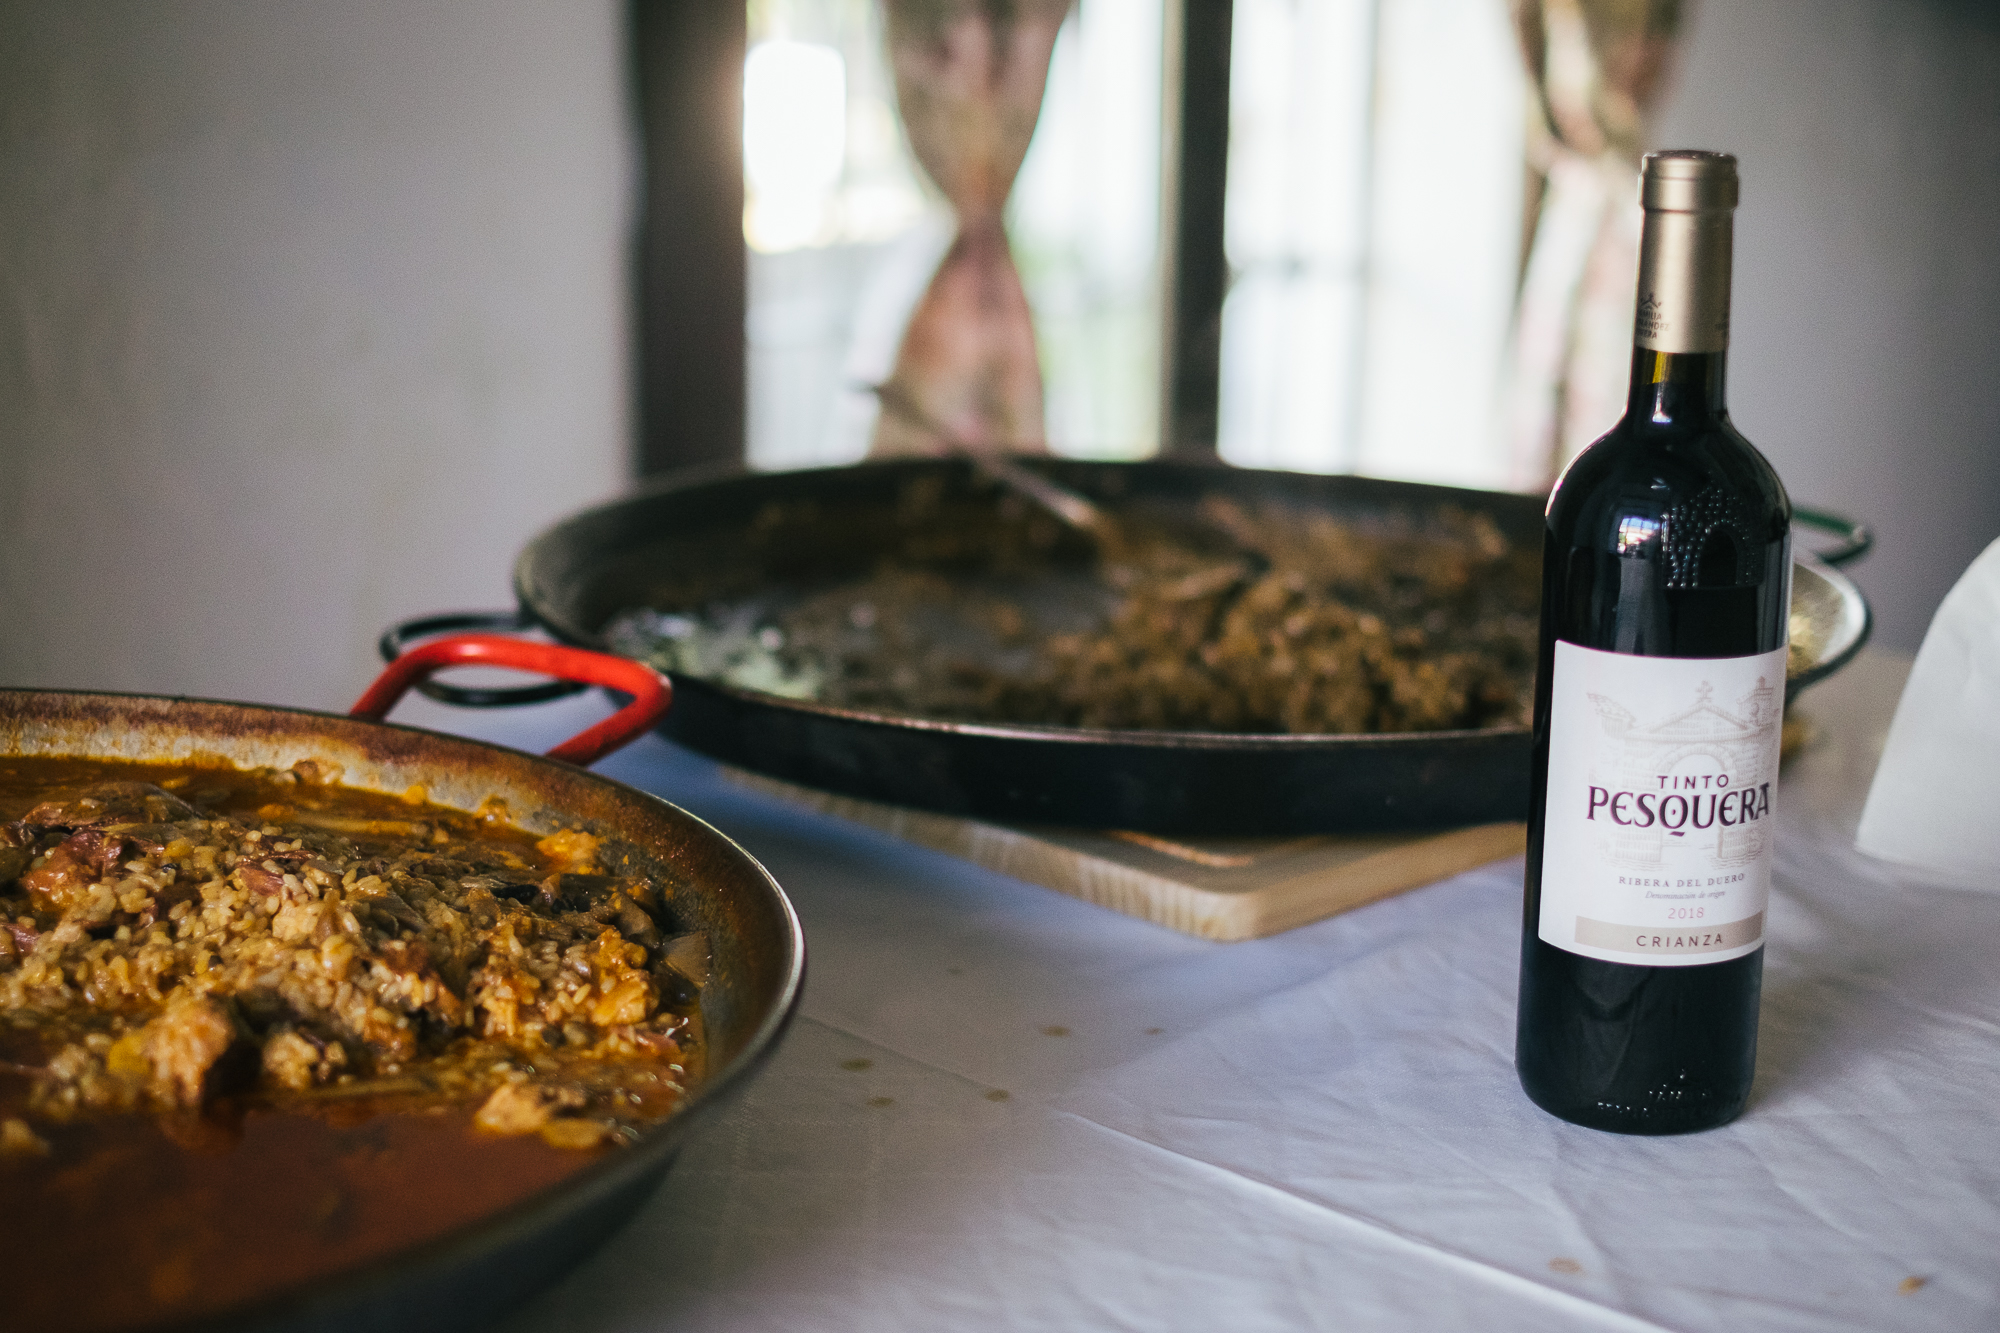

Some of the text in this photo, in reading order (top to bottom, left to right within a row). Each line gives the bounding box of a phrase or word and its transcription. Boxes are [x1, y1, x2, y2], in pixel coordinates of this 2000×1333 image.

[1657, 774, 1729, 790] TINTO
[1586, 782, 1770, 837] PESQUERA
[1618, 872, 1746, 888] RIBERA DEL DUERO
[1697, 890, 1706, 899] de
[1667, 906, 1705, 920] 2018
[1636, 933, 1723, 948] CRIANZA
